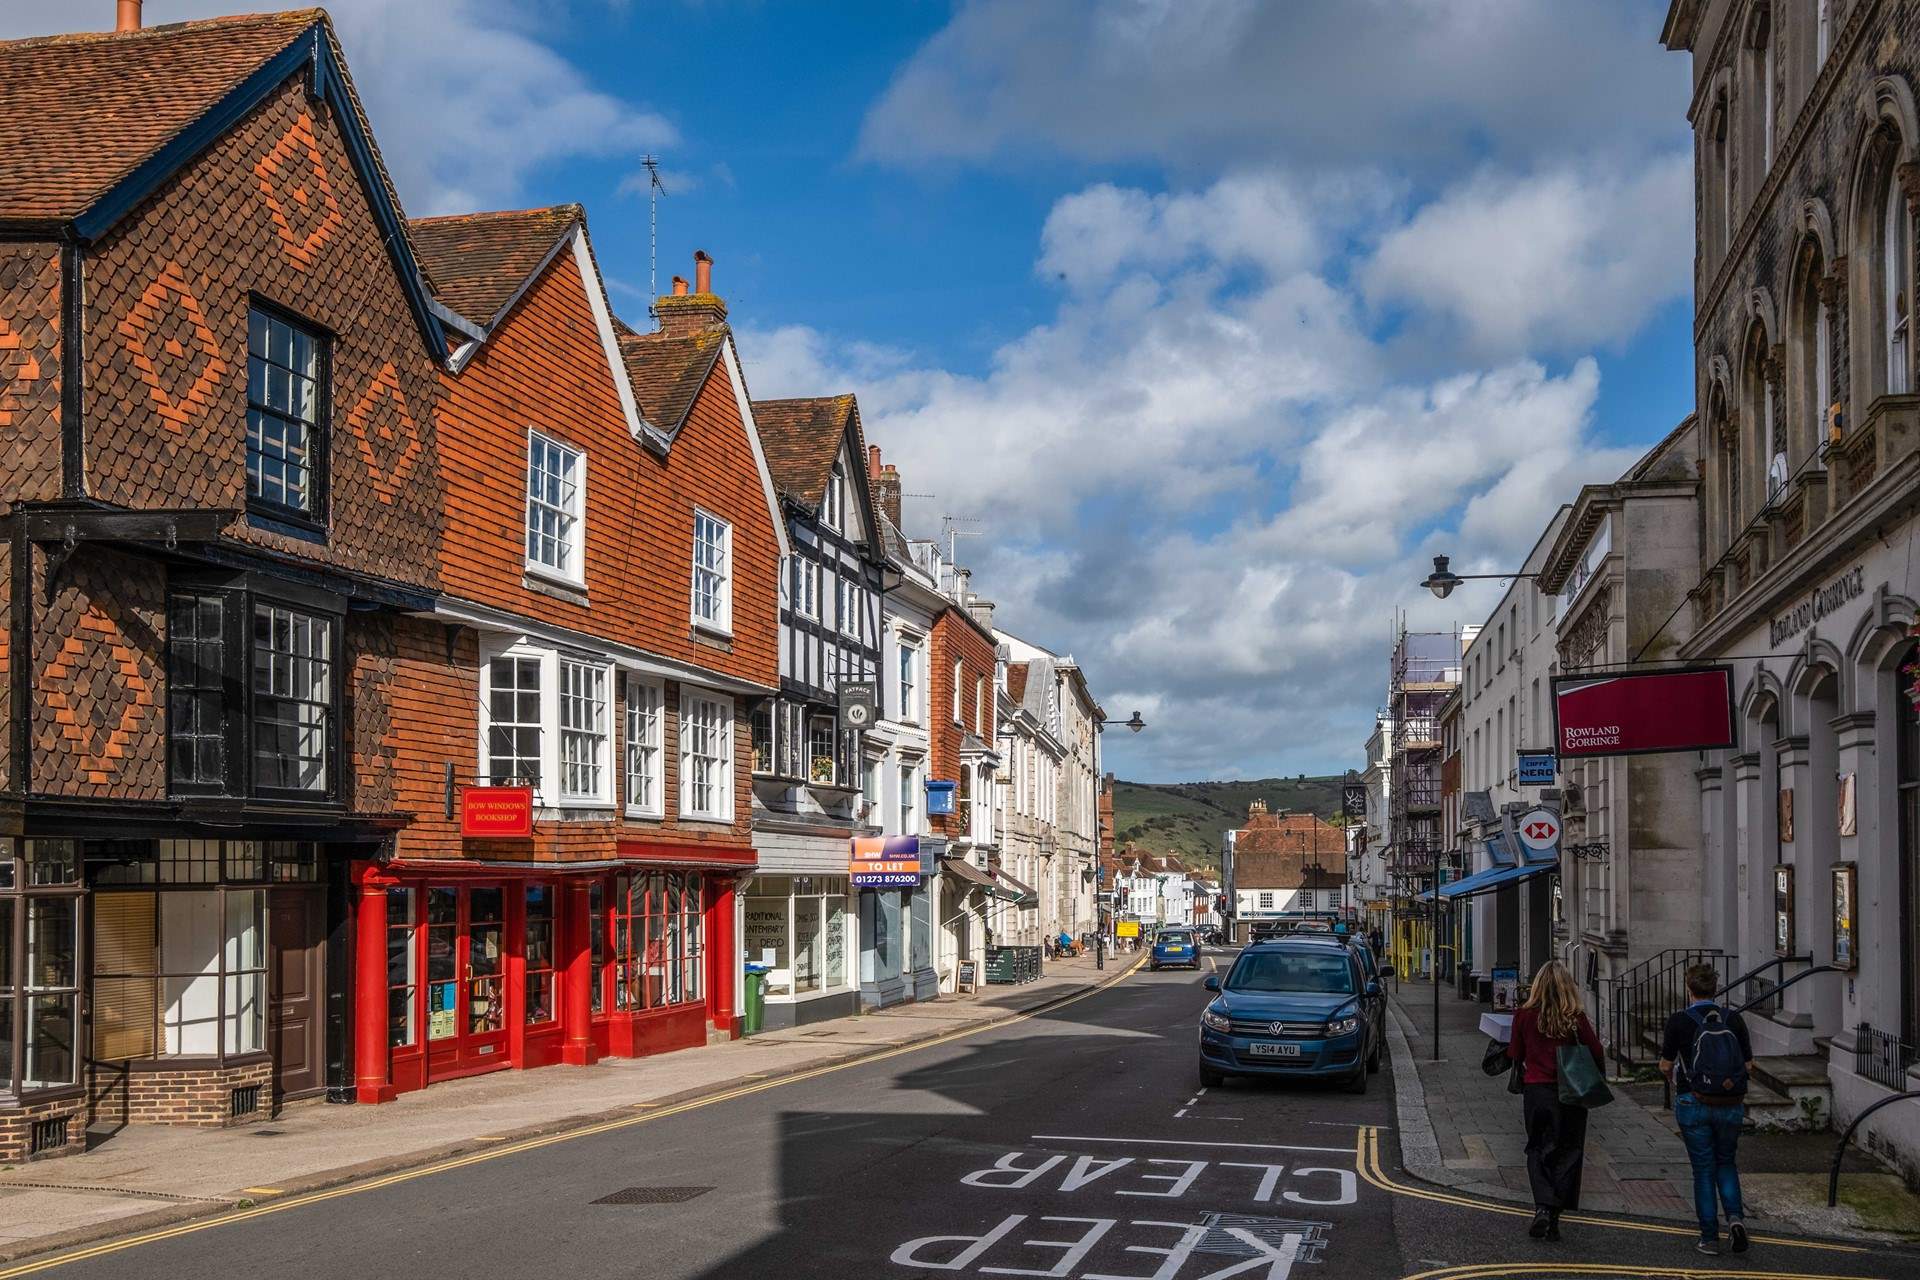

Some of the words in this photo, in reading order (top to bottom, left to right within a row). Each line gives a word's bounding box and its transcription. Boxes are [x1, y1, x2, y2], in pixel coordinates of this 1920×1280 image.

[1565, 726, 1620, 738] ROWLAND
[1566, 736, 1620, 749] GORRINGE
[1520, 768, 1554, 777] NERO
[868, 862, 883, 871] TO
[886, 862, 904, 871] LET
[856, 875, 883, 883] 01273
[885, 875, 916, 883] 876200
[745, 912, 784, 920] RADITIONAL
[745, 925, 784, 933] ONTEMPARY
[1255, 1045, 1275, 1054] YS14
[1277, 1046, 1295, 1055] AYU
[960, 1152, 1357, 1204] CLEAR
[890, 1214, 1303, 1280] KEEP
